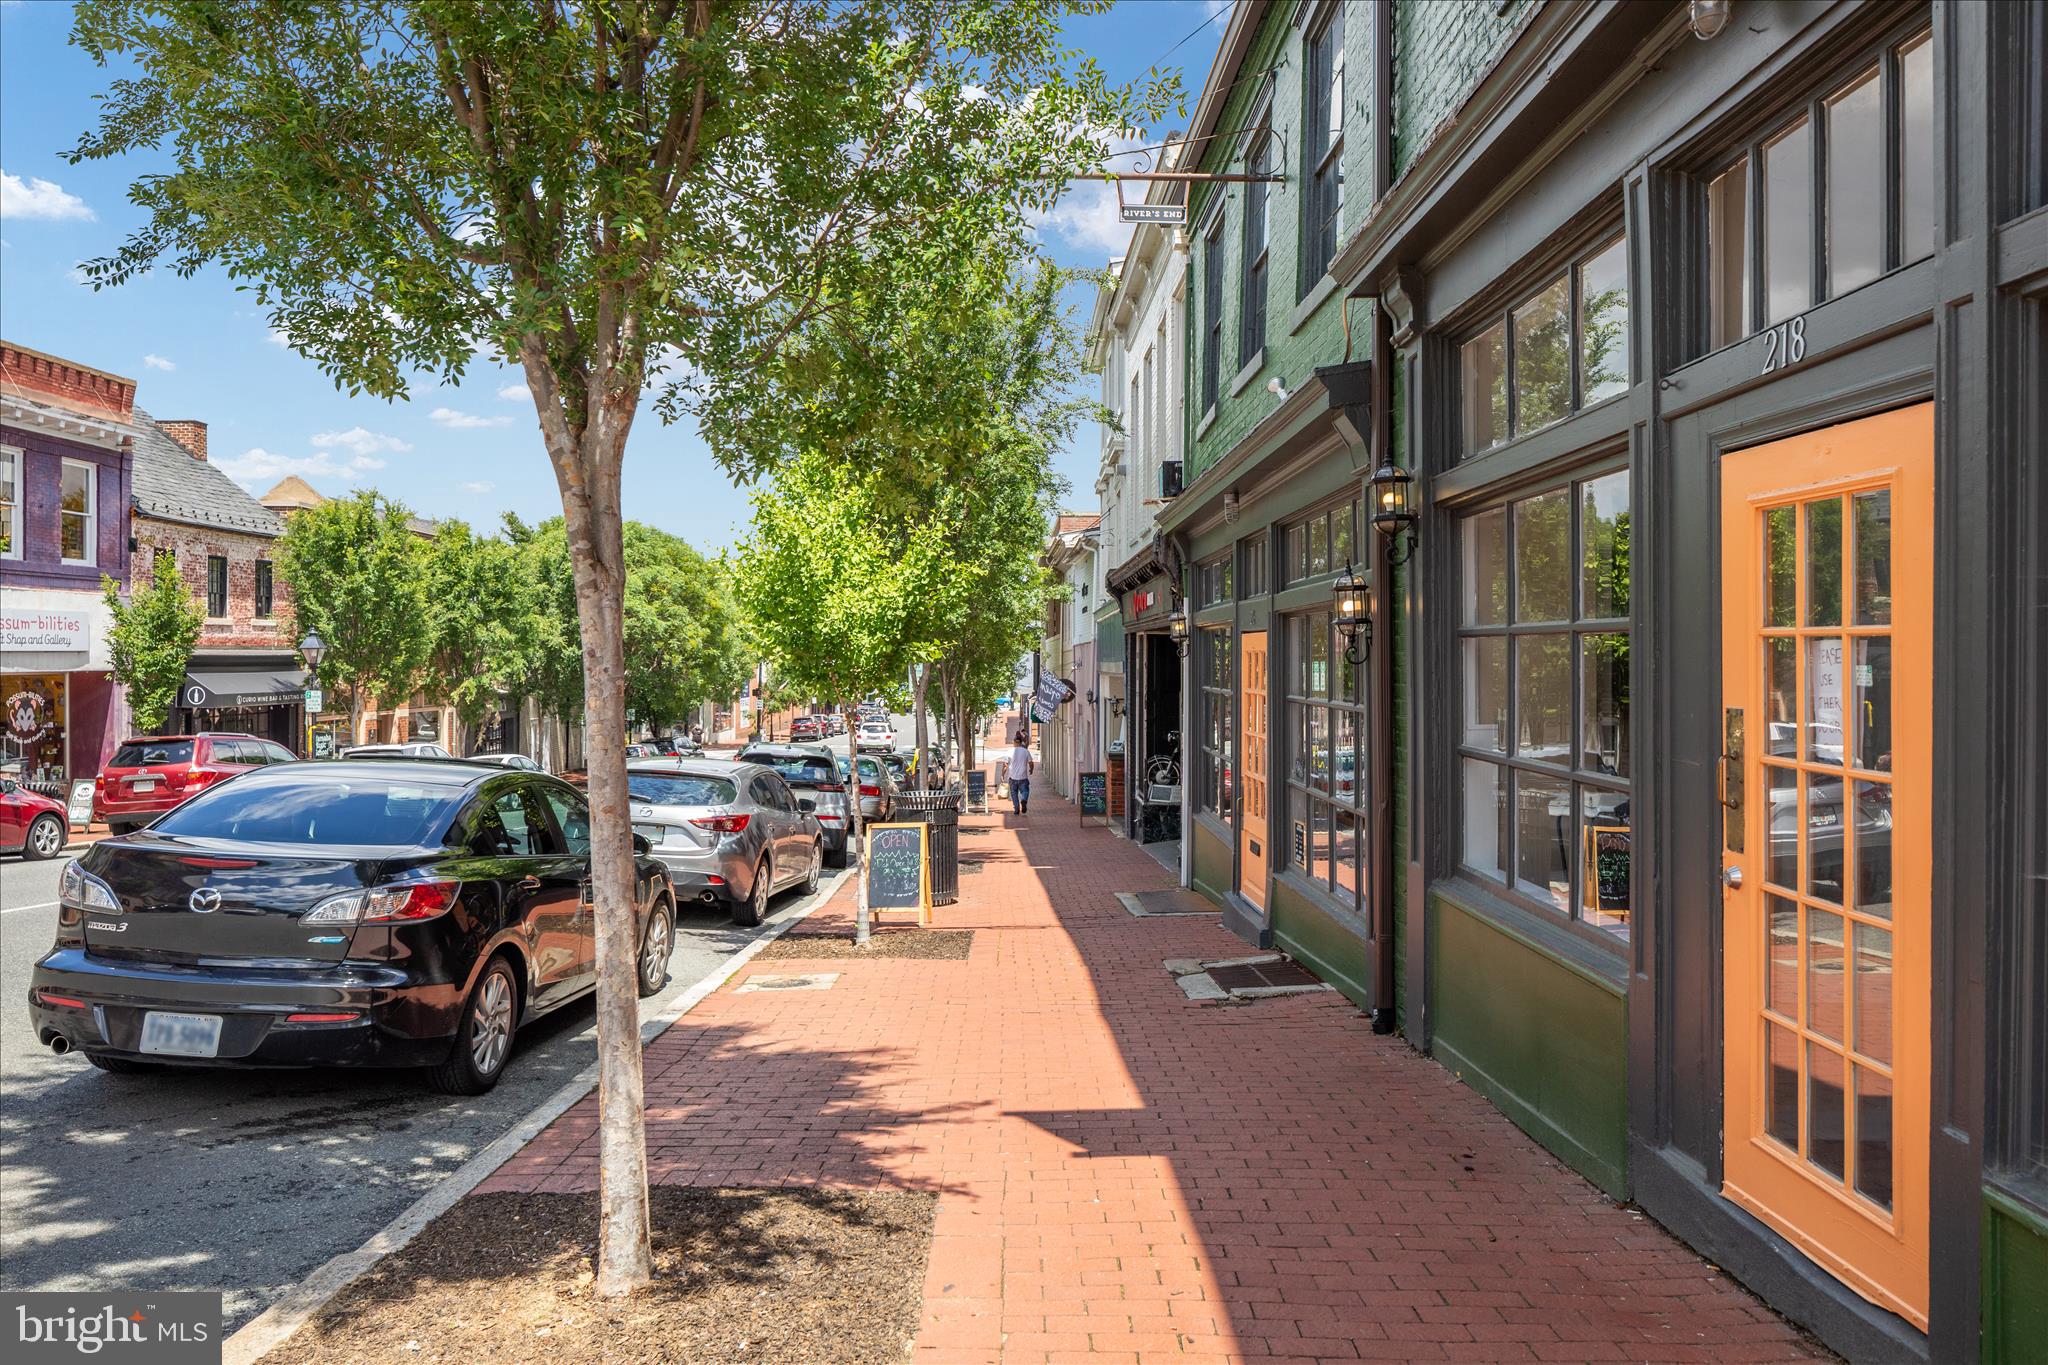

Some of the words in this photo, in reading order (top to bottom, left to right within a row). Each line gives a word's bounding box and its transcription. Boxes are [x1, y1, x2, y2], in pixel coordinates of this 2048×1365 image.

[1761, 316, 1806, 375] 218
[6, 633, 27, 647] Shop
[27, 634, 43, 645] and
[44, 633, 72, 648] Gallery
[882, 834, 909, 848] OPEN
